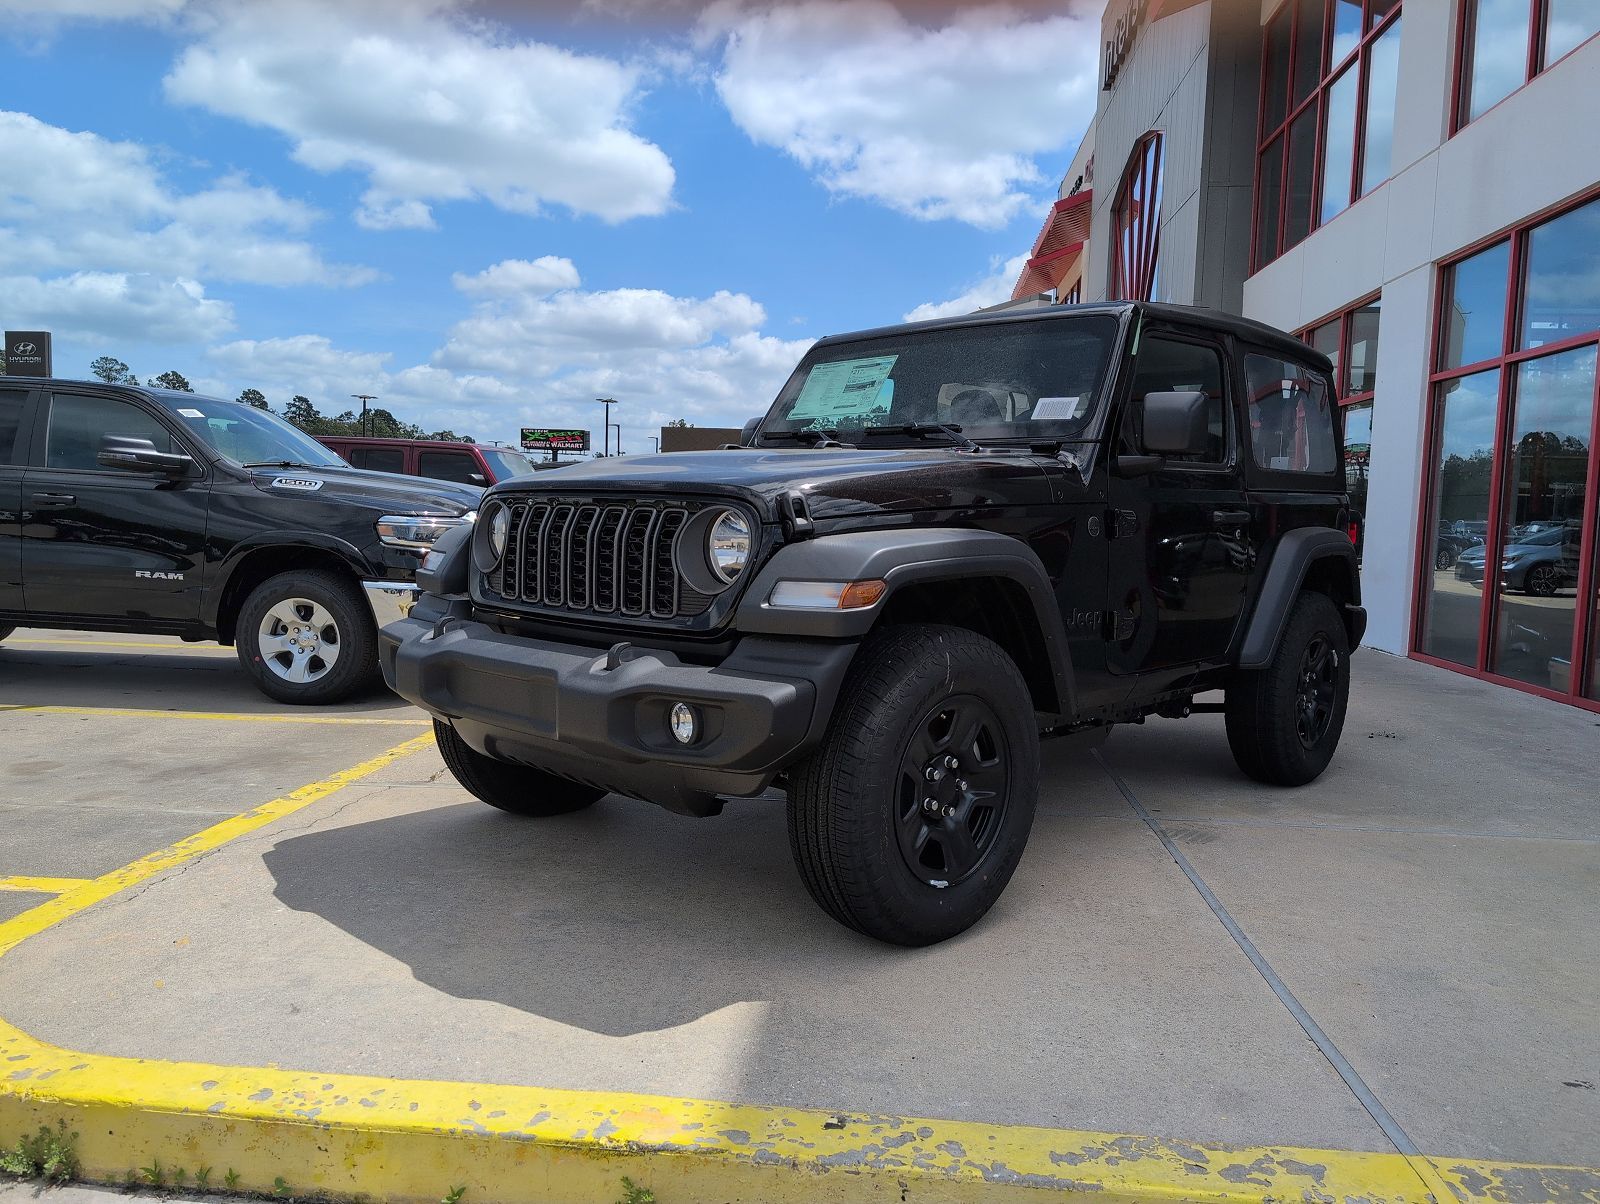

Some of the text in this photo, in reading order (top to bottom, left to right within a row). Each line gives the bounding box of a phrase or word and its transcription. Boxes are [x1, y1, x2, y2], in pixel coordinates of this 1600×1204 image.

[276, 479, 318, 487] 1500
[135, 570, 184, 580] RAM
[1066, 608, 1101, 630] Jeep
